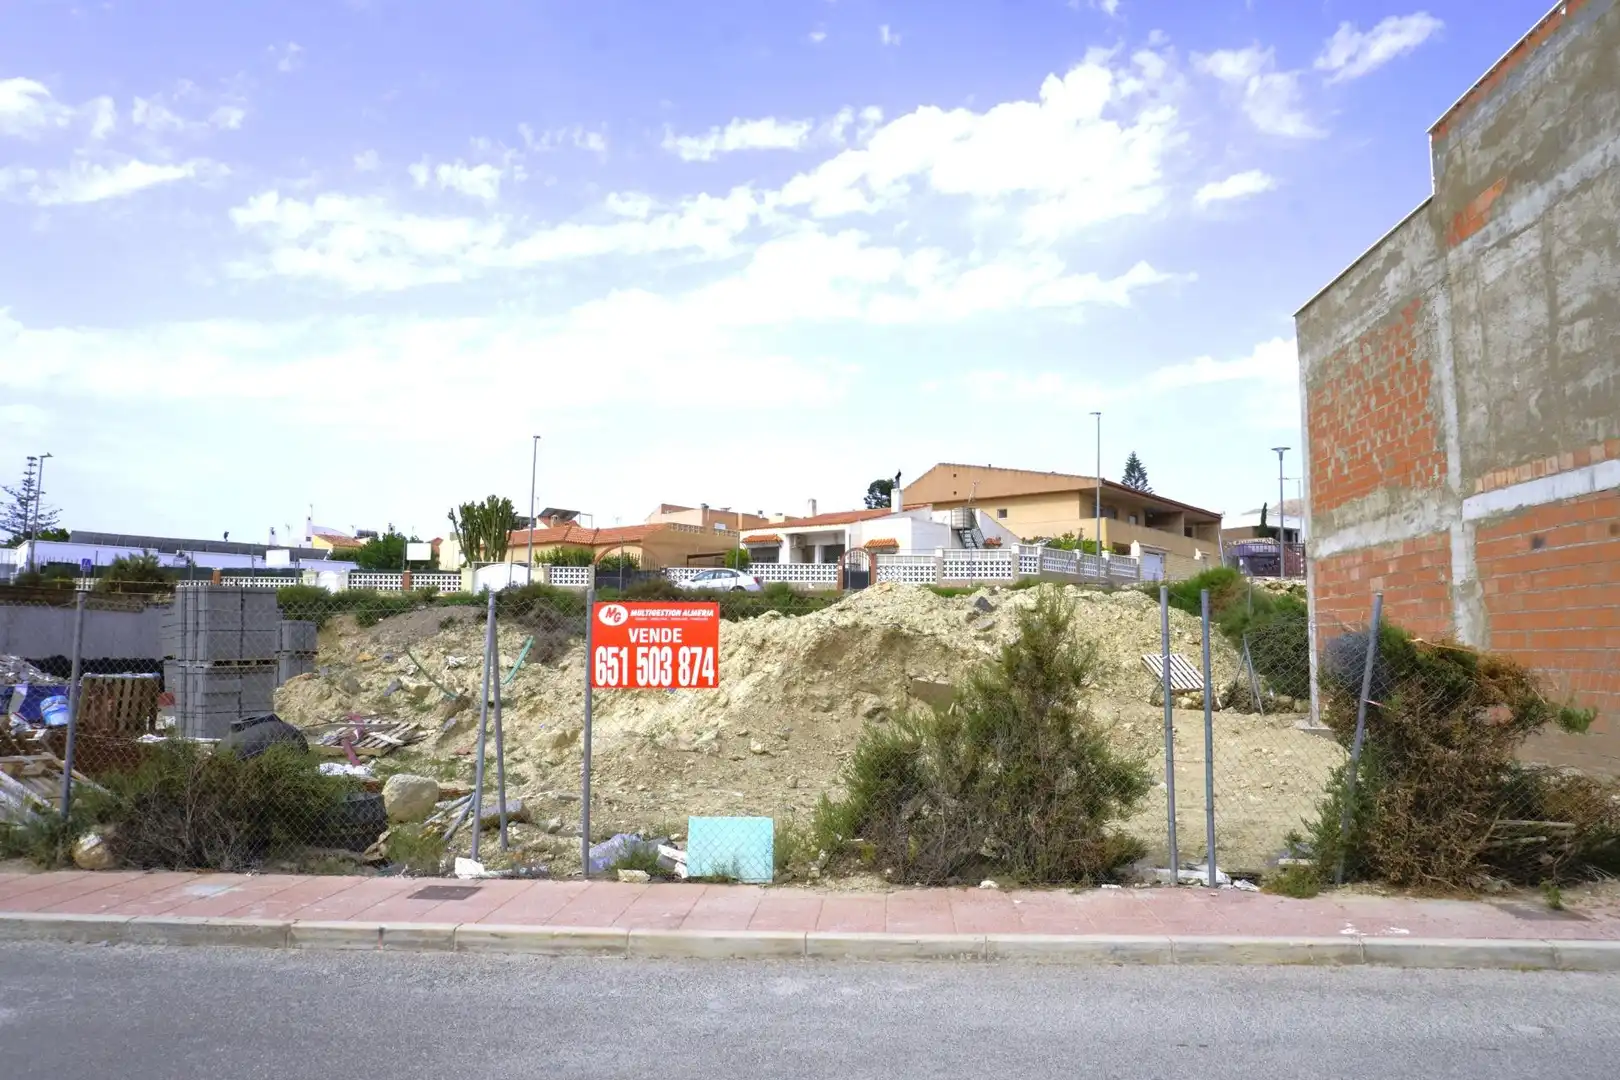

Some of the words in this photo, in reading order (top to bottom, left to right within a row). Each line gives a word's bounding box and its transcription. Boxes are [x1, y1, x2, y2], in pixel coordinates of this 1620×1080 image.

[605, 607, 622, 623] MG
[628, 628, 682, 643] VENDE
[595, 646, 628, 686] 651
[636, 646, 672, 686] 503
[678, 646, 715, 686] 874
